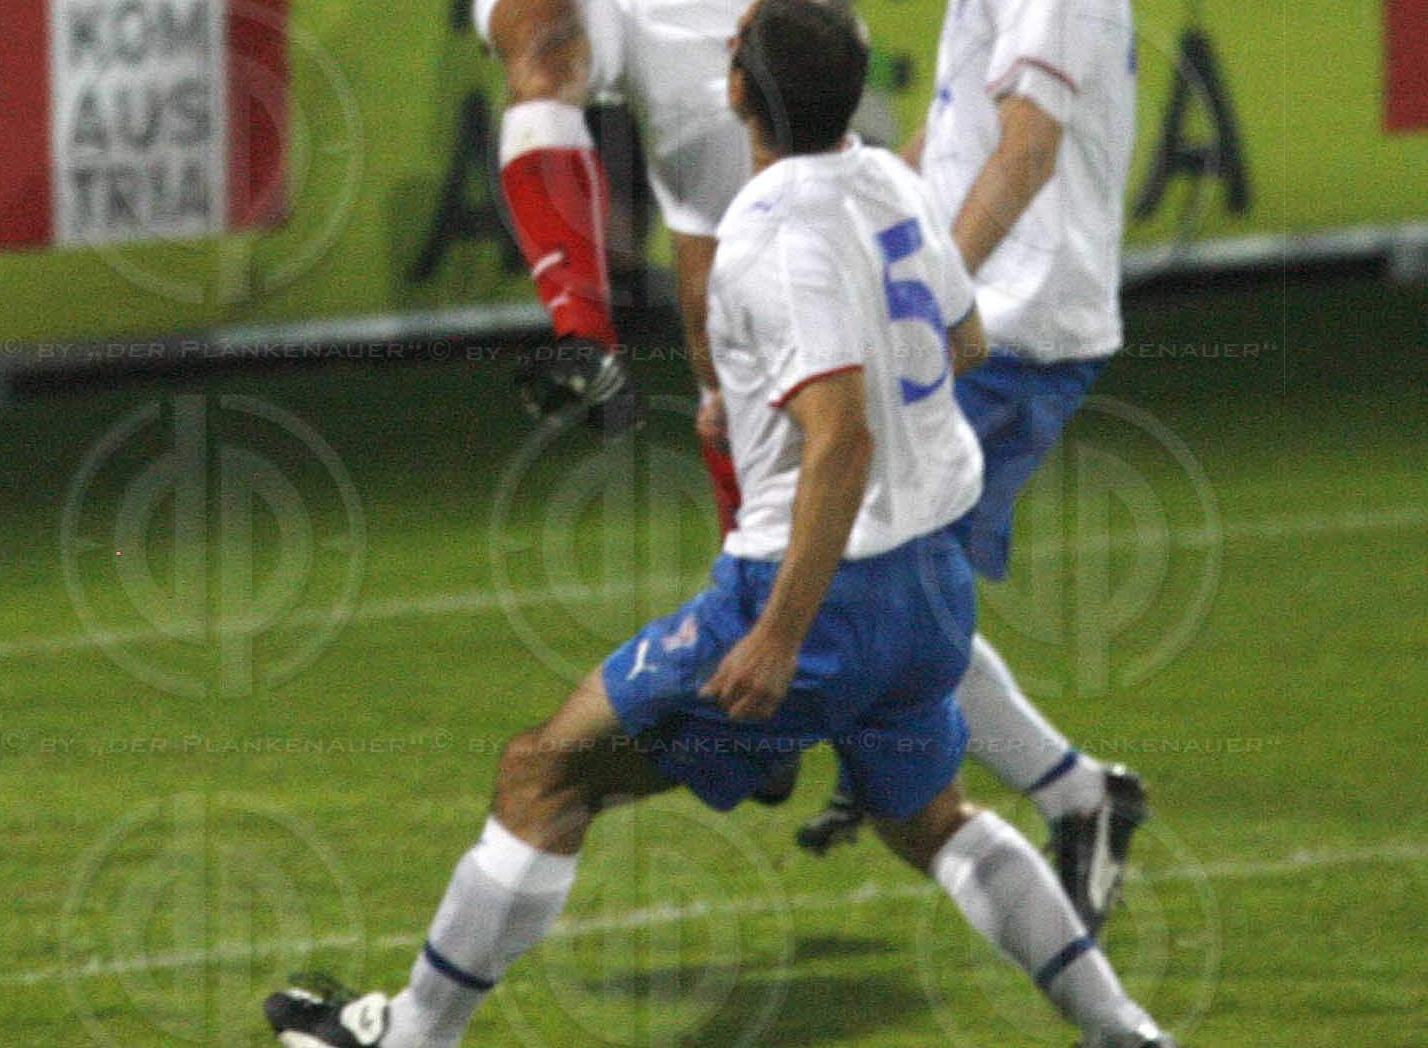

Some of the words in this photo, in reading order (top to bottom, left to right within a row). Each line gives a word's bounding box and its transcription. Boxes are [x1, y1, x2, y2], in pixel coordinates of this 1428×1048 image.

[71, 78, 211, 150] AUS
[71, 158, 210, 227] TRIA
[874, 216, 954, 407] 5
